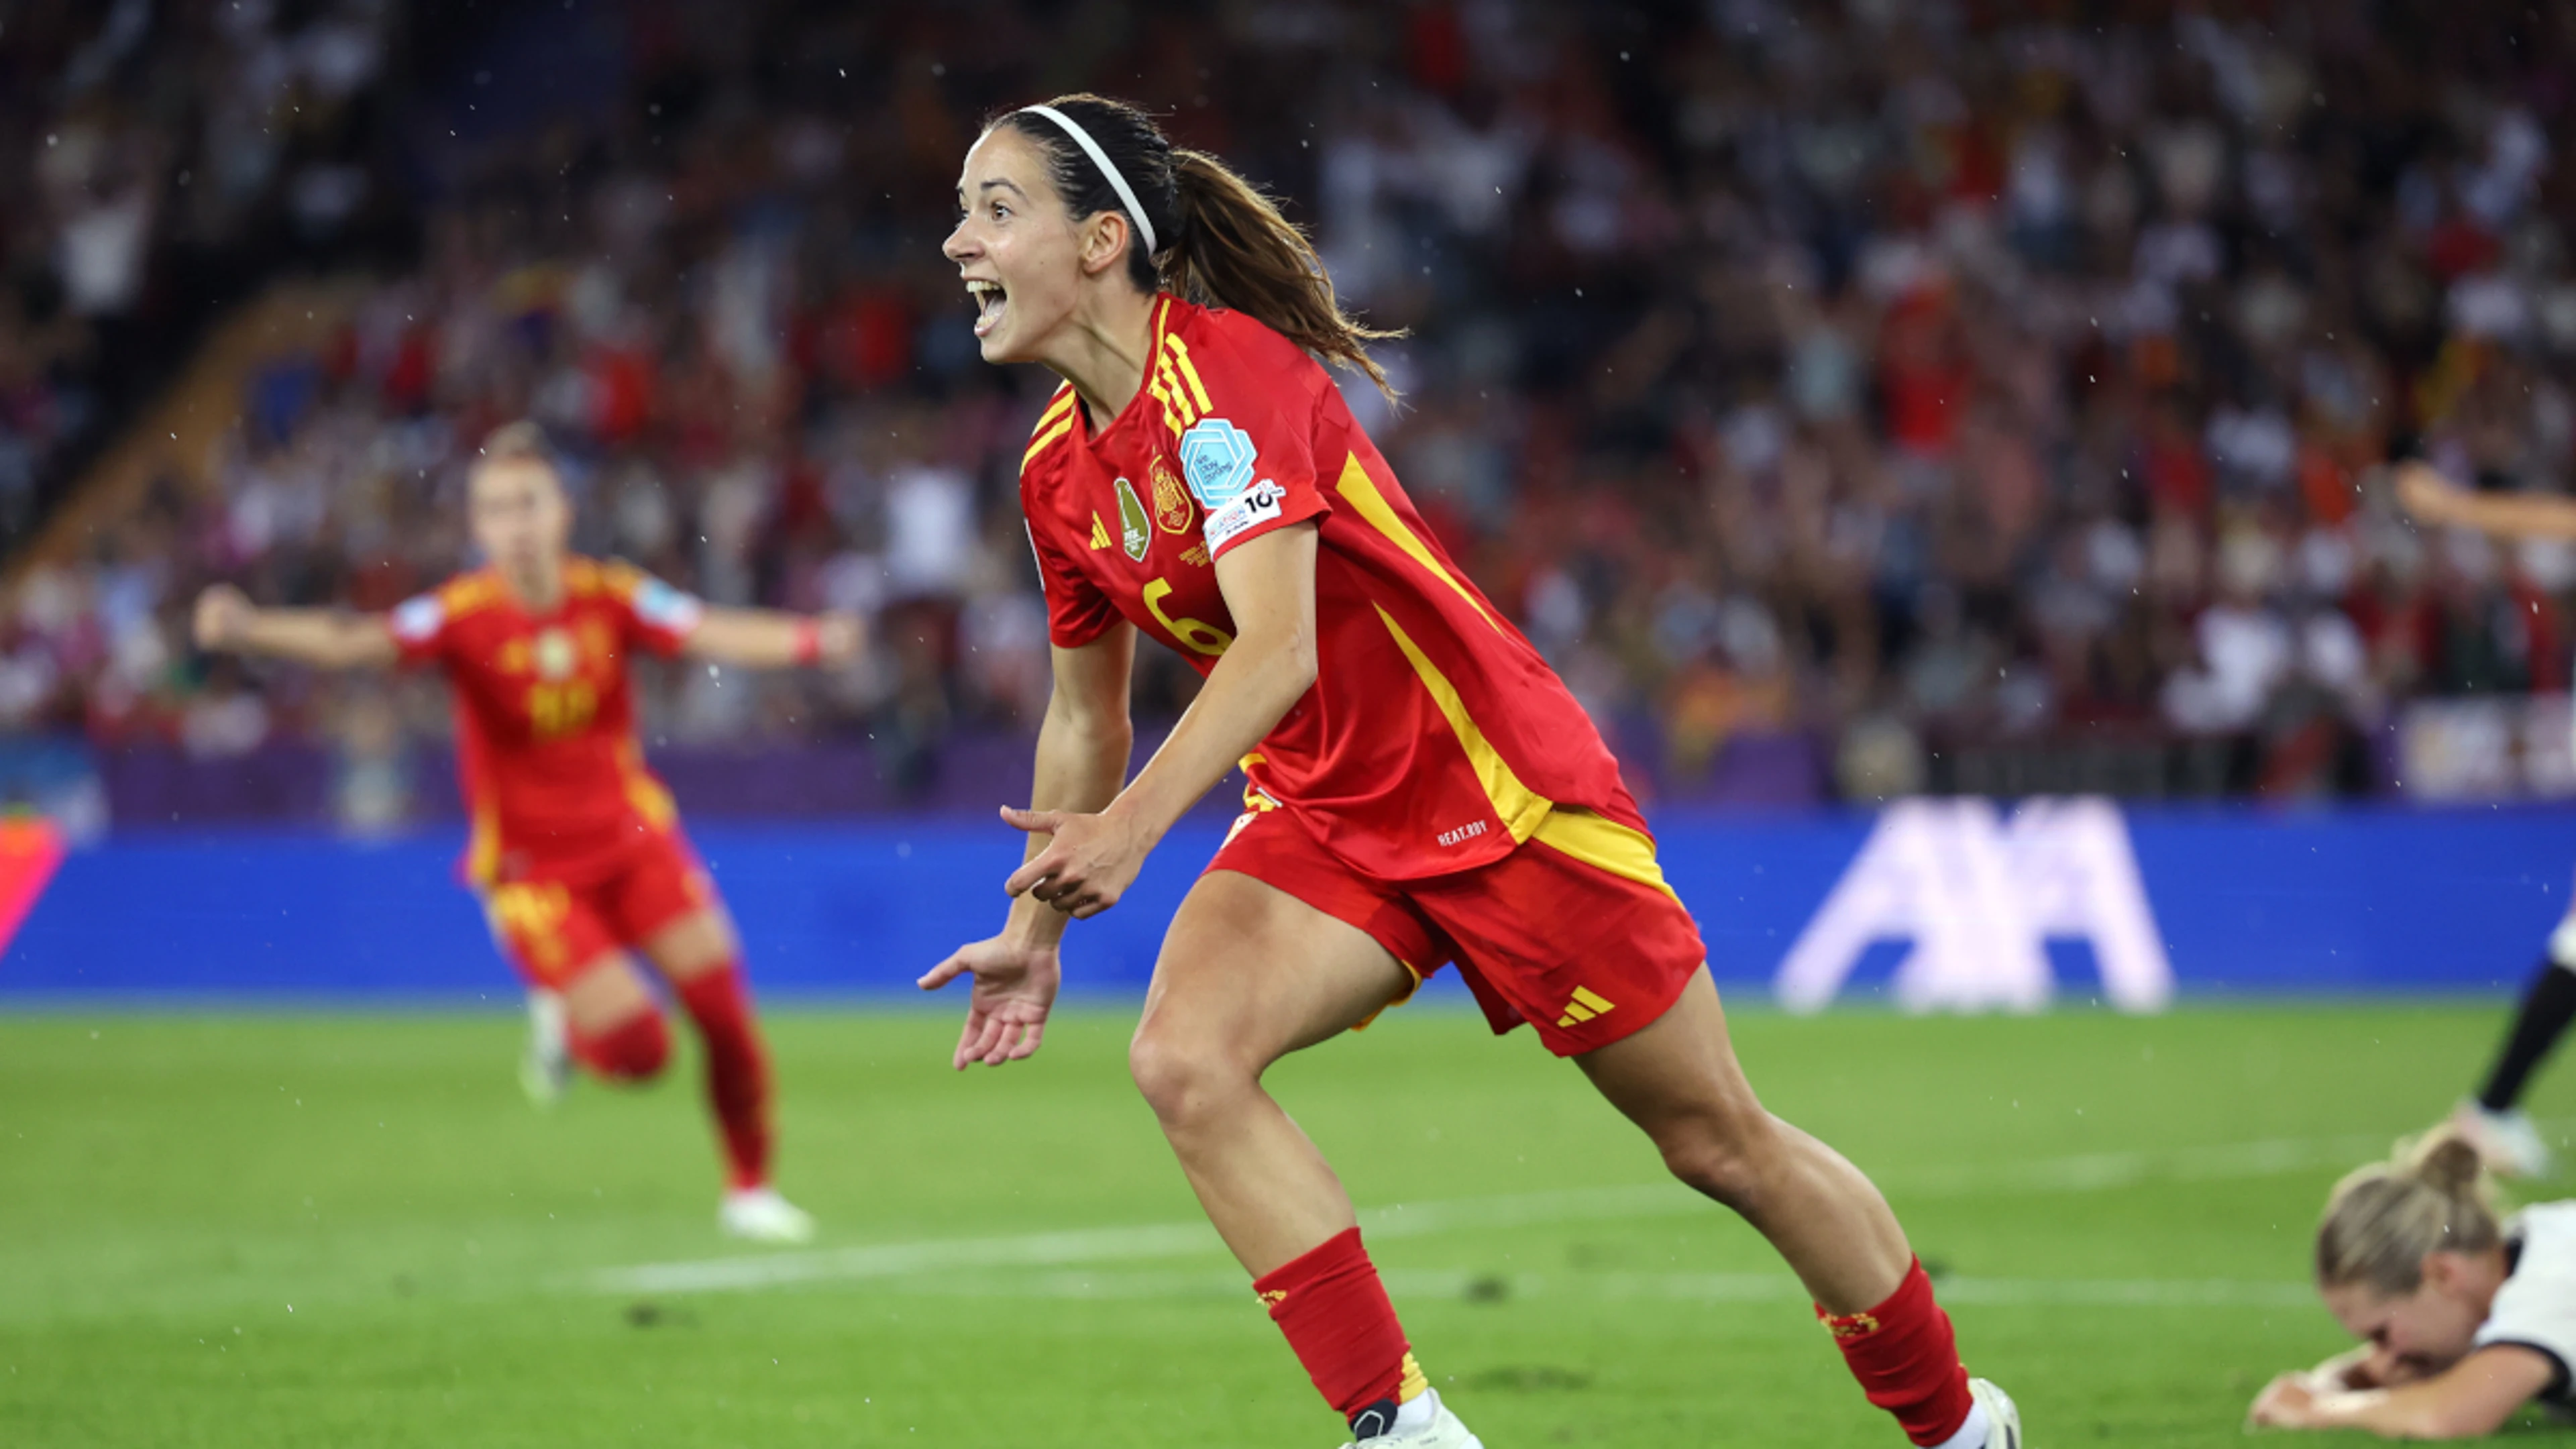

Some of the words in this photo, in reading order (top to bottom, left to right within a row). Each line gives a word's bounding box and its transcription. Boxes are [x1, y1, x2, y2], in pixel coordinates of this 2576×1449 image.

[1244, 492, 1273, 513] 10
[1142, 577, 1234, 655] 6
[1774, 796, 2174, 1013] AXA
